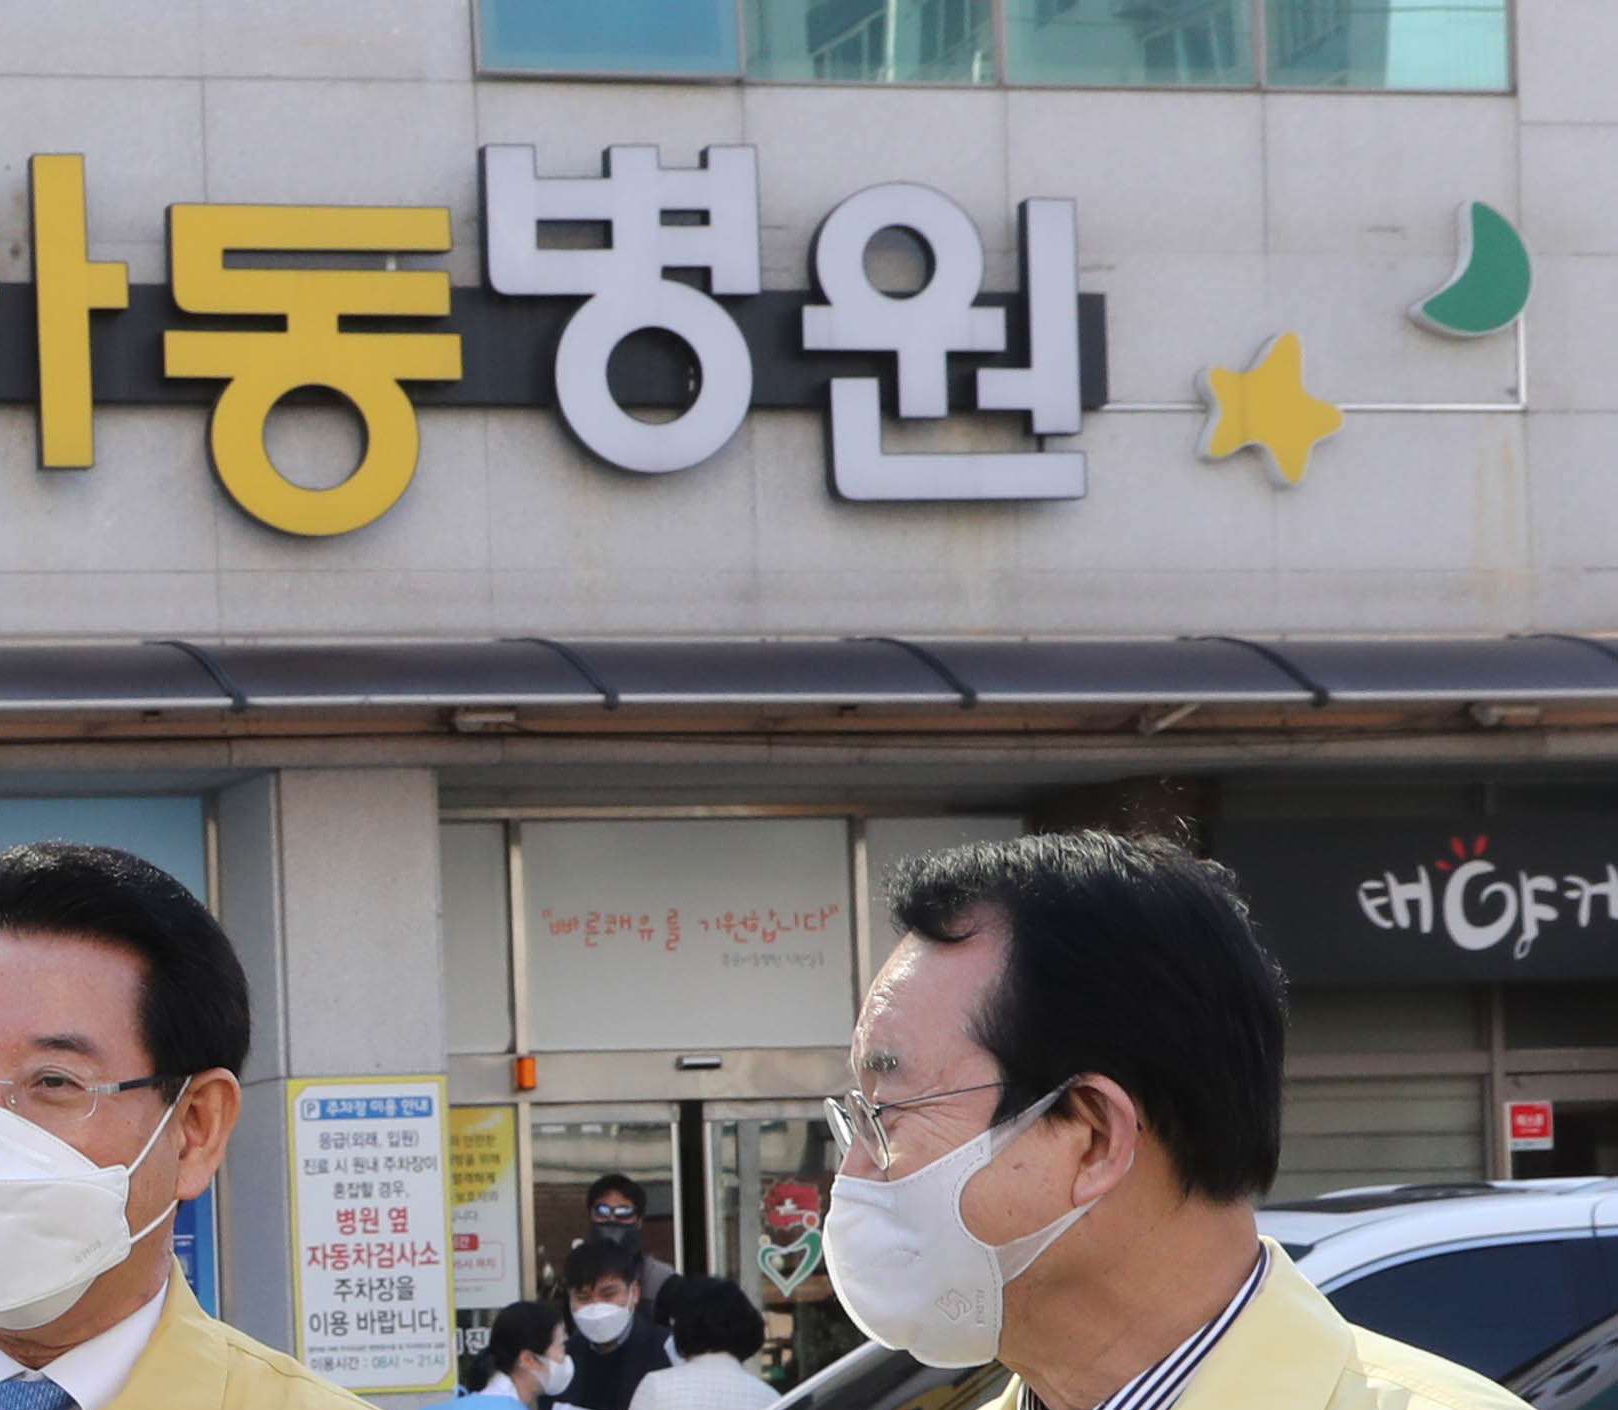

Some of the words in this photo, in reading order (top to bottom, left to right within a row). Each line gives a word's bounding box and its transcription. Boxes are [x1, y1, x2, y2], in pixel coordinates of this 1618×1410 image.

[326, 1100, 367, 1116] 주차장
[370, 1099, 397, 1116] 이용
[401, 1098, 430, 1115] 안내
[387, 1129, 420, 1148] 입원)
[303, 1158, 330, 1175] 진료
[334, 1157, 349, 1173] 시
[353, 1157, 379, 1174] 원내
[383, 1155, 438, 1173] 주차장이
[333, 1181, 374, 1199] 혼잡할
[336, 1207, 381, 1236] 병원
[387, 1206, 410, 1235] 옆
[307, 1241, 441, 1271] 자동차검사소
[333, 1275, 416, 1303] 주차장을
[309, 1311, 350, 1337] 이용
[357, 1308, 445, 1335] 바랍니다.
[310, 1355, 361, 1373] 이용시간
